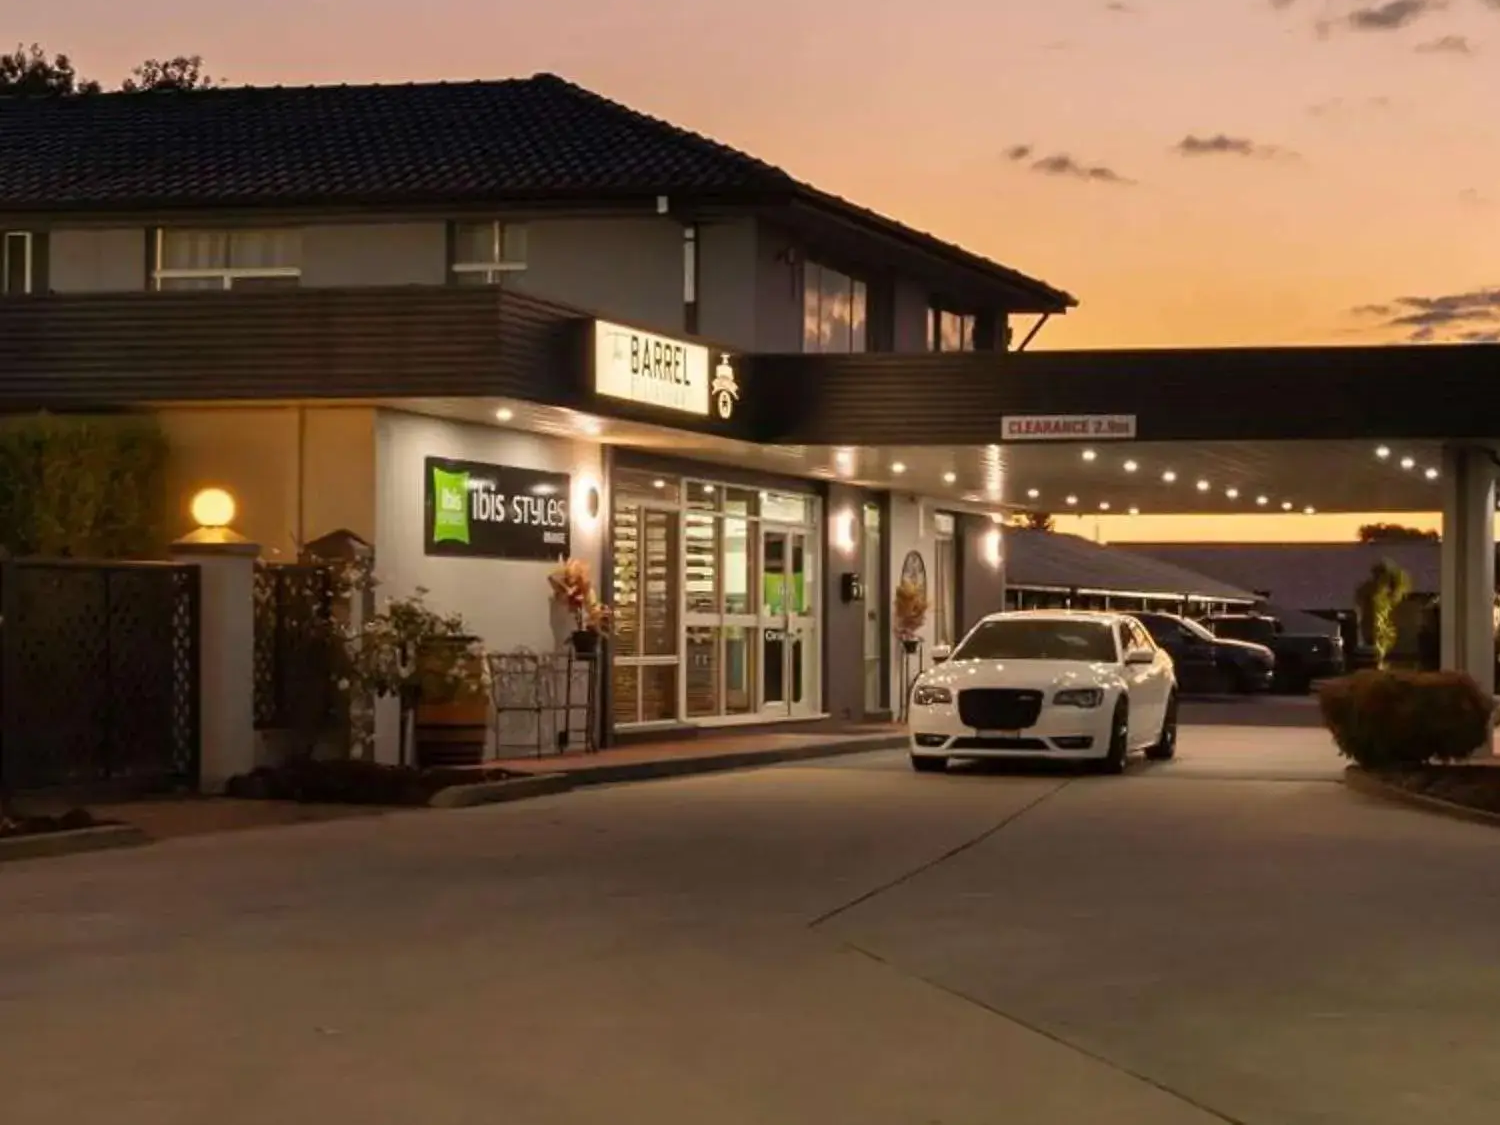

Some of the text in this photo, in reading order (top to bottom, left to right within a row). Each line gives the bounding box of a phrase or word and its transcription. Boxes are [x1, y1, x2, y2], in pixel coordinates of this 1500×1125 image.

[630, 334, 692, 387] BARREL
[1008, 419, 1090, 435] CLEARANCE
[471, 482, 506, 523] ibis
